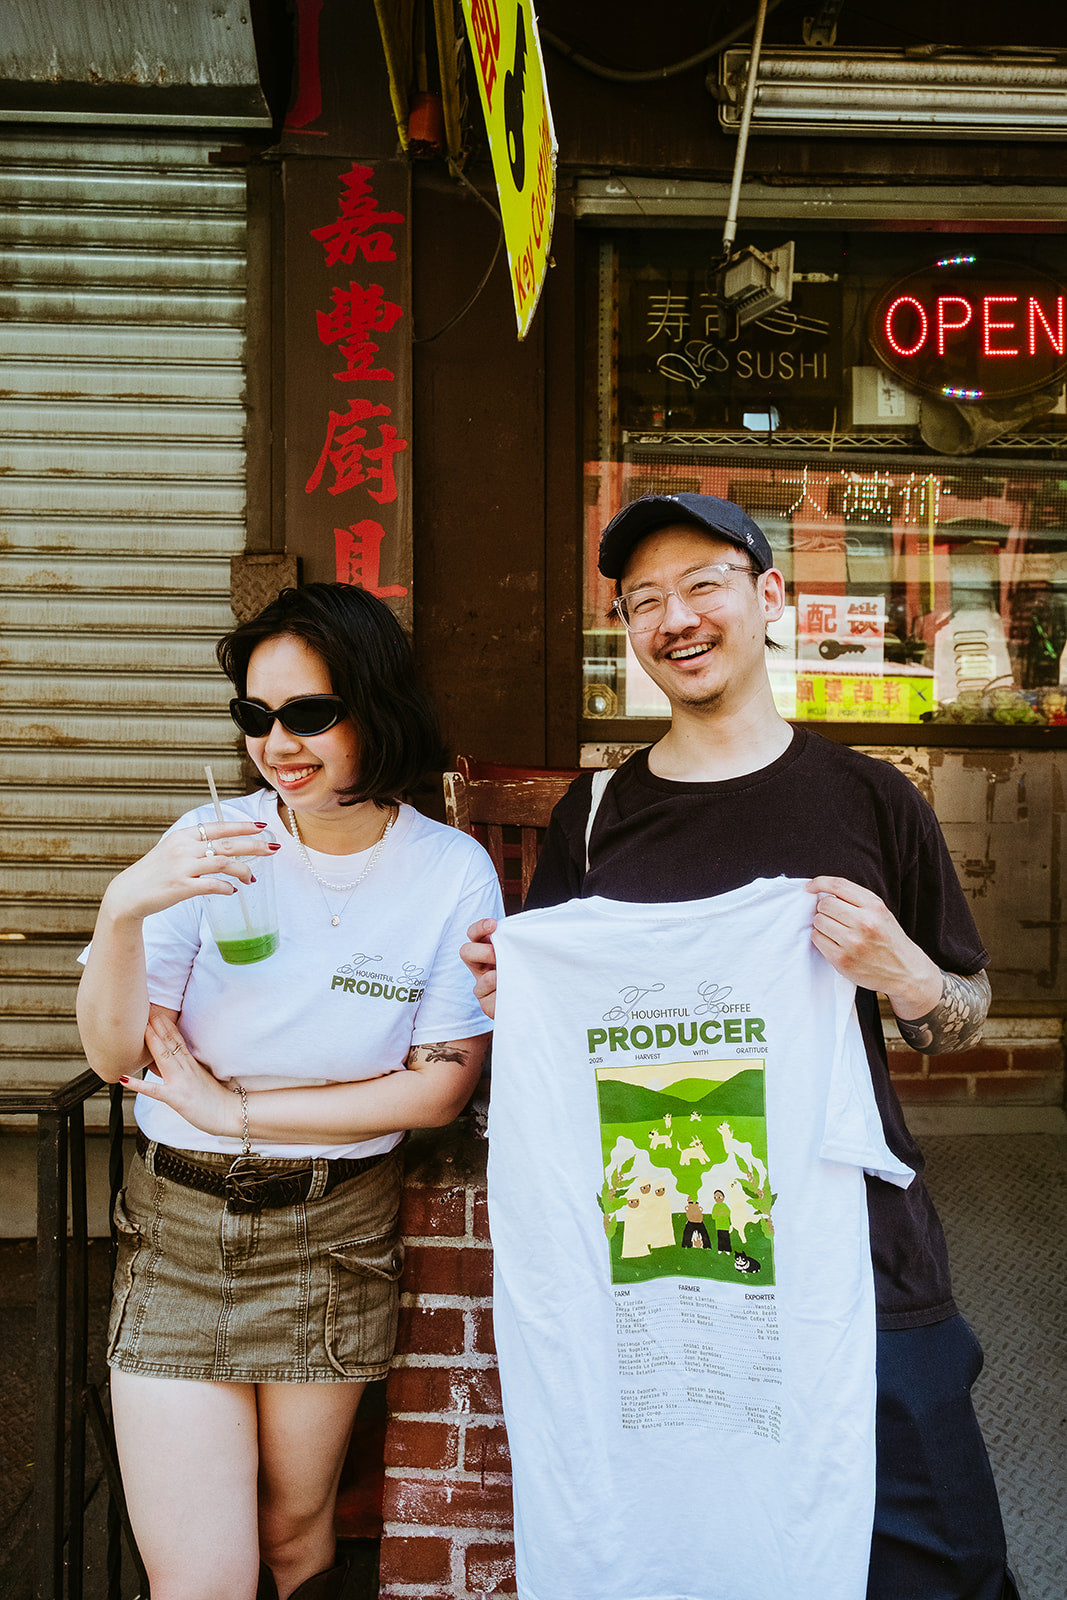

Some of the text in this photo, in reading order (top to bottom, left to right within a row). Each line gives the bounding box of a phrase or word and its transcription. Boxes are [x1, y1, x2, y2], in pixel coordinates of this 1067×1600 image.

[515, 234, 535, 309] Key
[885, 296, 1064, 355] OPEN
[736, 350, 827, 380] SUSHI
[336, 952, 394, 983] THOUGHTFUL
[331, 975, 425, 1002] PRODUCER
[602, 980, 751, 1032] THOUGHTFUL COFFEE
[587, 1018, 767, 1054] PRODUCER
[588, 1056, 604, 1064] 2025
[678, 1284, 700, 1292] FARMER
